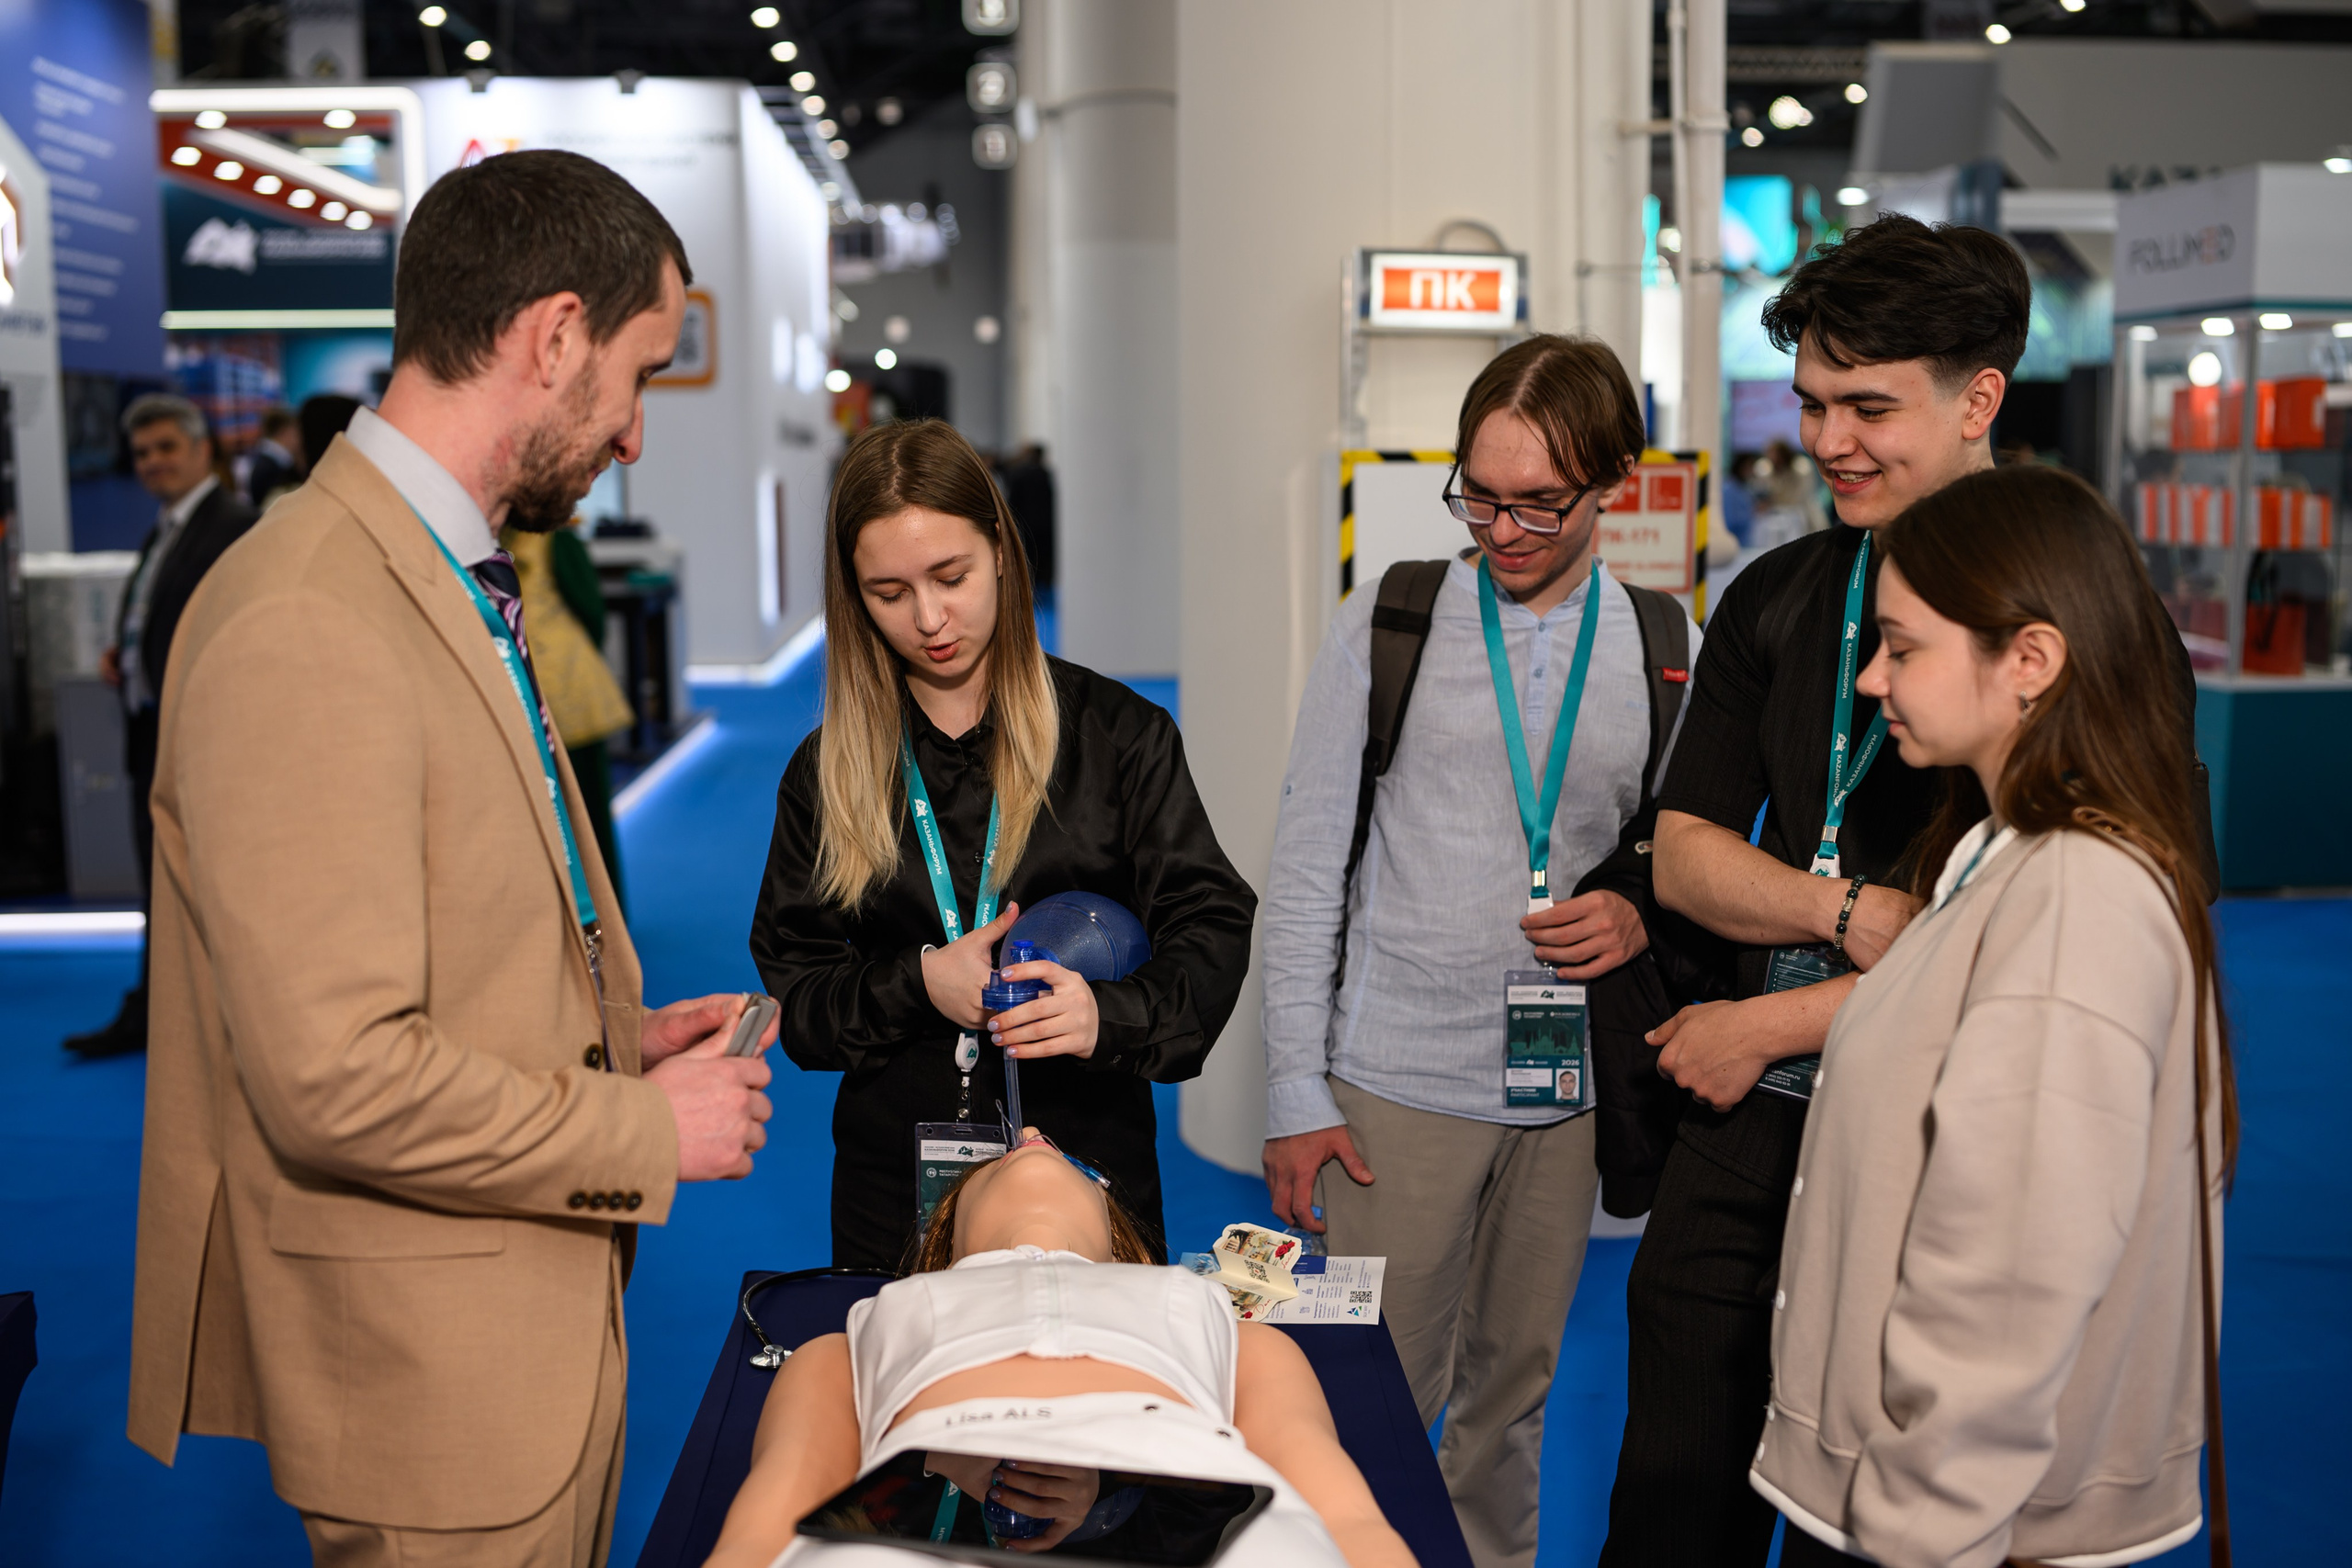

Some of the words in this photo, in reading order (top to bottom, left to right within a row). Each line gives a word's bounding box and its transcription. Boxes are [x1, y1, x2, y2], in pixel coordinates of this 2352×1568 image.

[1410, 270, 1477, 309] ПК
[1842, 643, 1852, 699] КАЗАНЬФОРУМ
[1846, 734, 1878, 788] КАЗАНЬФОРУМ
[922, 819, 943, 875] КАЗАНЬФОРУМ
